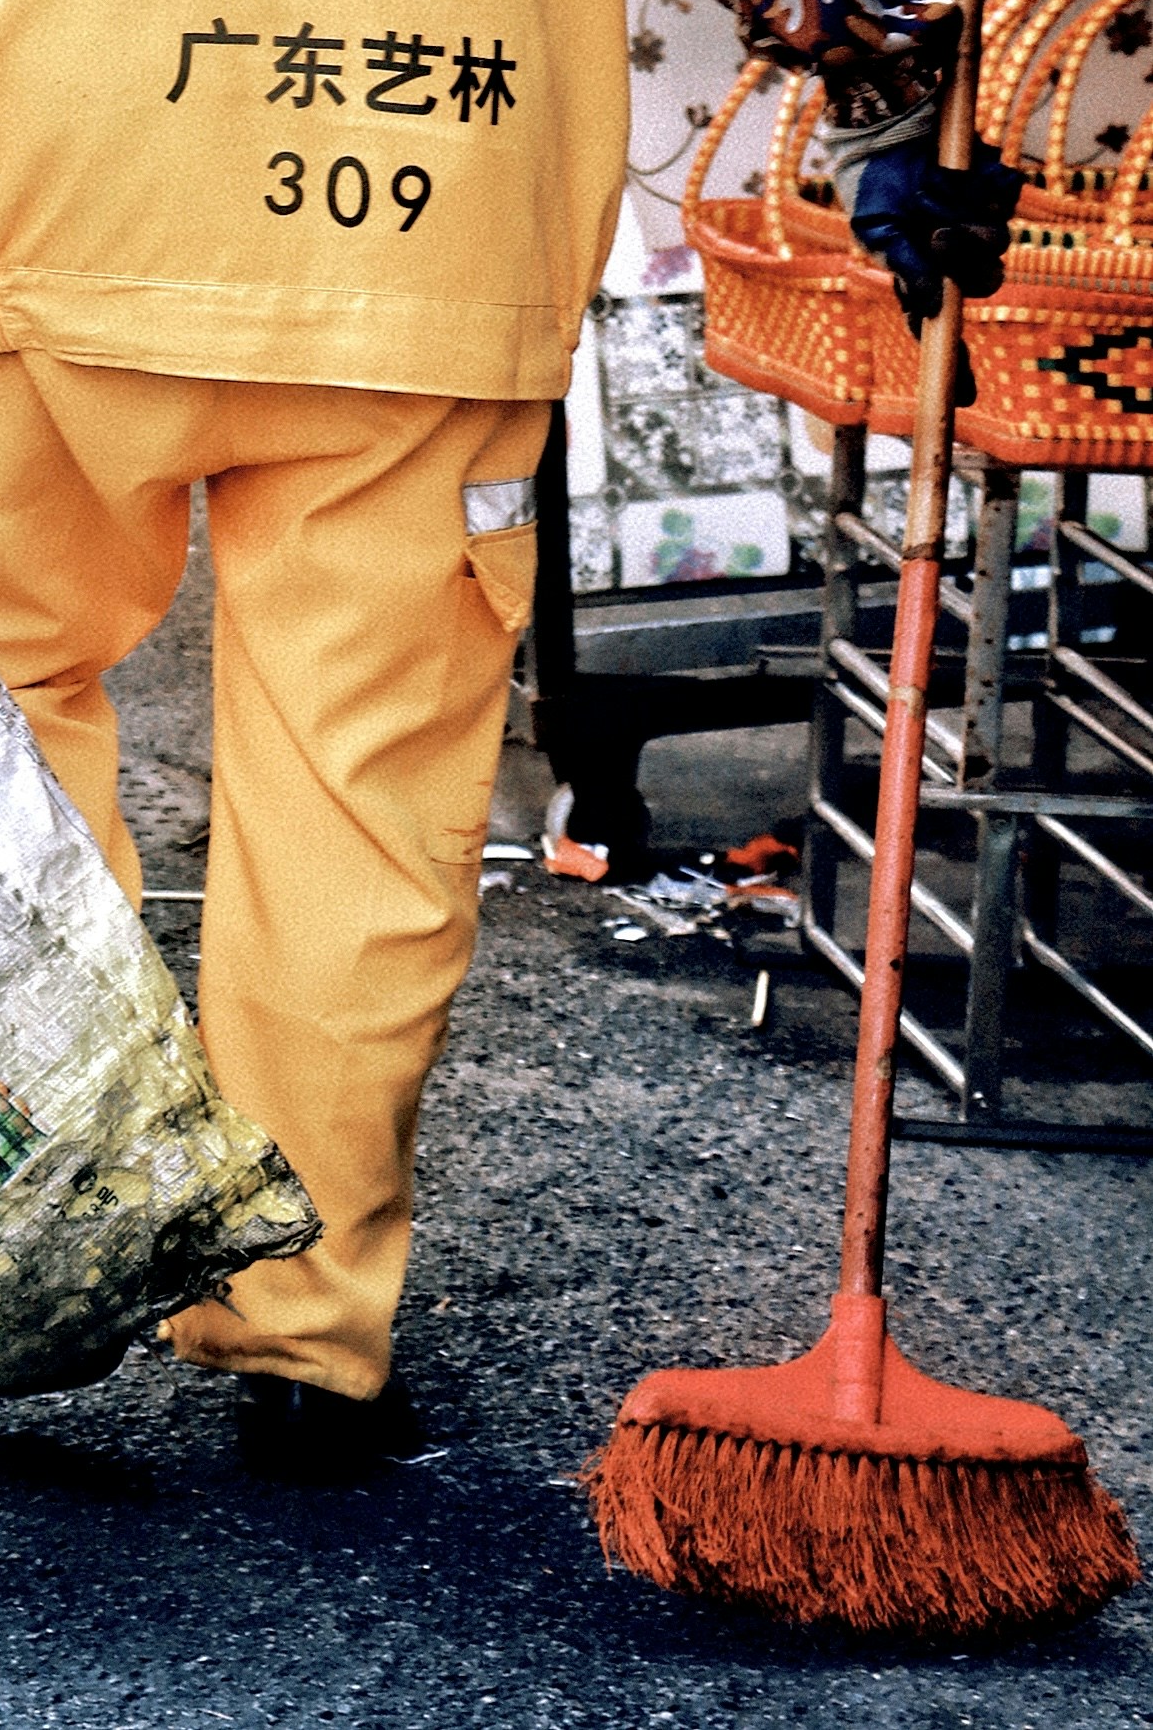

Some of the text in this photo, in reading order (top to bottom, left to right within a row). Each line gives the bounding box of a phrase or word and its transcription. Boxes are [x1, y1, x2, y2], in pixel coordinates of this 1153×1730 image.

[166, 17, 517, 126] 广东艺林
[264, 151, 431, 232] 309
